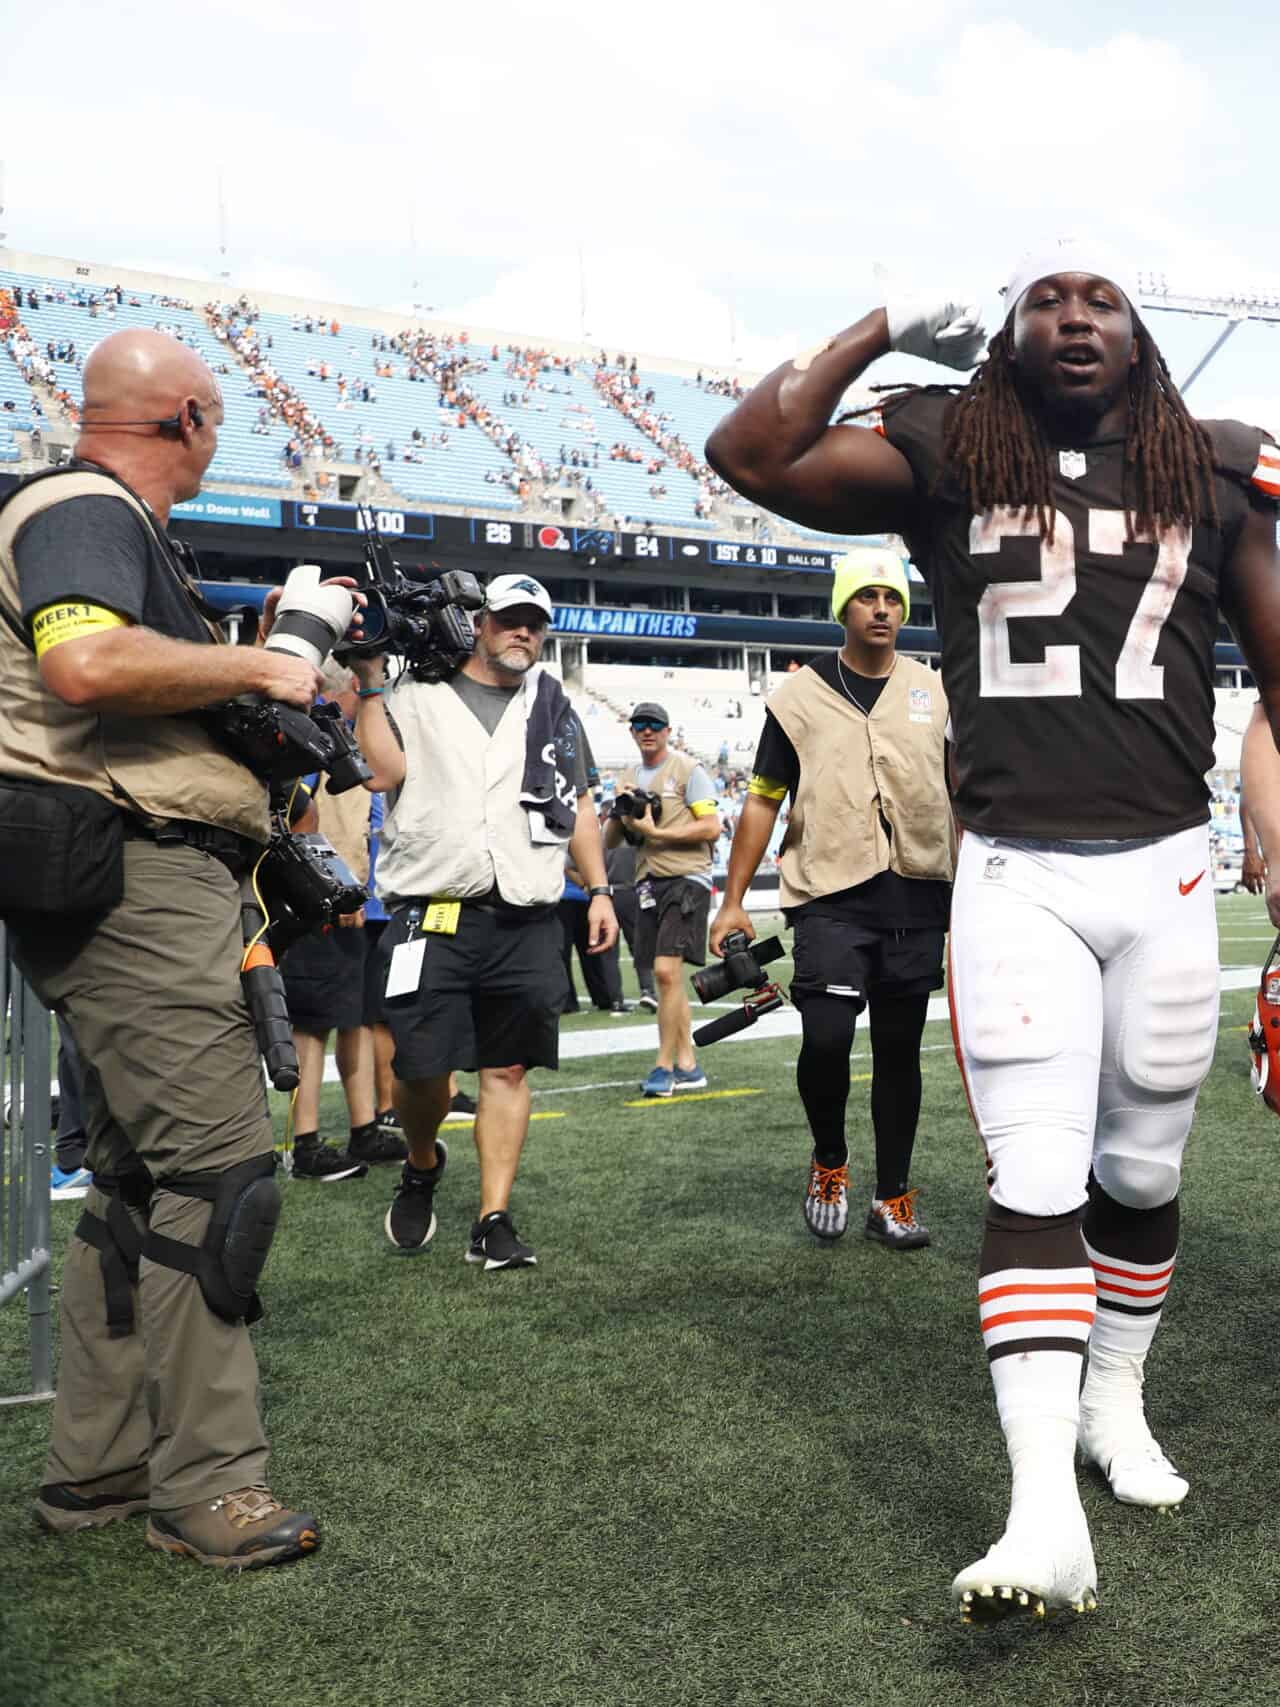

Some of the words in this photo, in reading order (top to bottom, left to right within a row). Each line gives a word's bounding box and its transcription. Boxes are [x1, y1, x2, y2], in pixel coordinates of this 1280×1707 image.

[486, 522, 512, 544] 26
[635, 535, 659, 557] 24
[716, 545, 740, 561] 1ST
[745, 548, 757, 562] &
[761, 548, 777, 565] 10
[969, 504, 1193, 699] 27
[34, 606, 80, 633] WEEK
[83, 606, 91, 617] 1
[547, 607, 595, 631] LINA
[600, 611, 697, 637] PANTHERS
